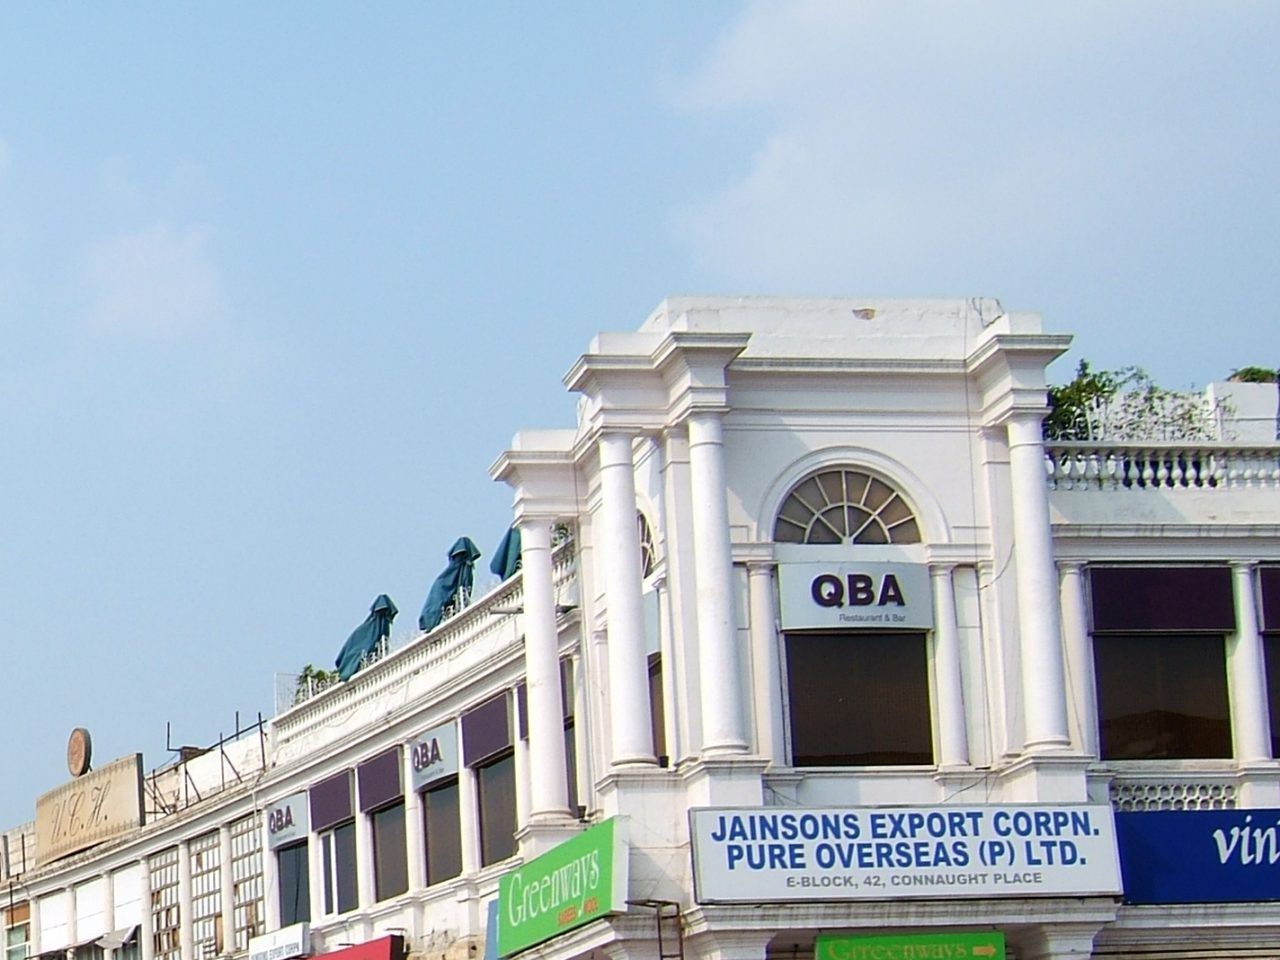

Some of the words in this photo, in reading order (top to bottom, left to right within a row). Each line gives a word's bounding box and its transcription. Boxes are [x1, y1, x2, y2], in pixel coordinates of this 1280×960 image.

[811, 574, 906, 608] QBA
[839, 613, 884, 622] Restaurant
[884, 613, 890, 621] &
[892, 613, 906, 622] Bar
[413, 738, 443, 773] QBA
[270, 805, 296, 834] QBA
[711, 813, 860, 842] JAINSONS
[870, 811, 984, 839] EXPORT
[993, 811, 1100, 837] CORPN.
[727, 843, 806, 870] PURE
[815, 841, 970, 869] OVERSEAS
[979, 840, 1015, 867] (P)
[1026, 840, 1087, 866] LTD.
[1213, 815, 1280, 865] vin
[508, 850, 600, 927] Greenways
[786, 875, 859, 889] E-BLOCK,
[863, 875, 886, 889] 42,
[891, 873, 988, 887] CONNAUGHT
[994, 872, 1043, 884] PLACE
